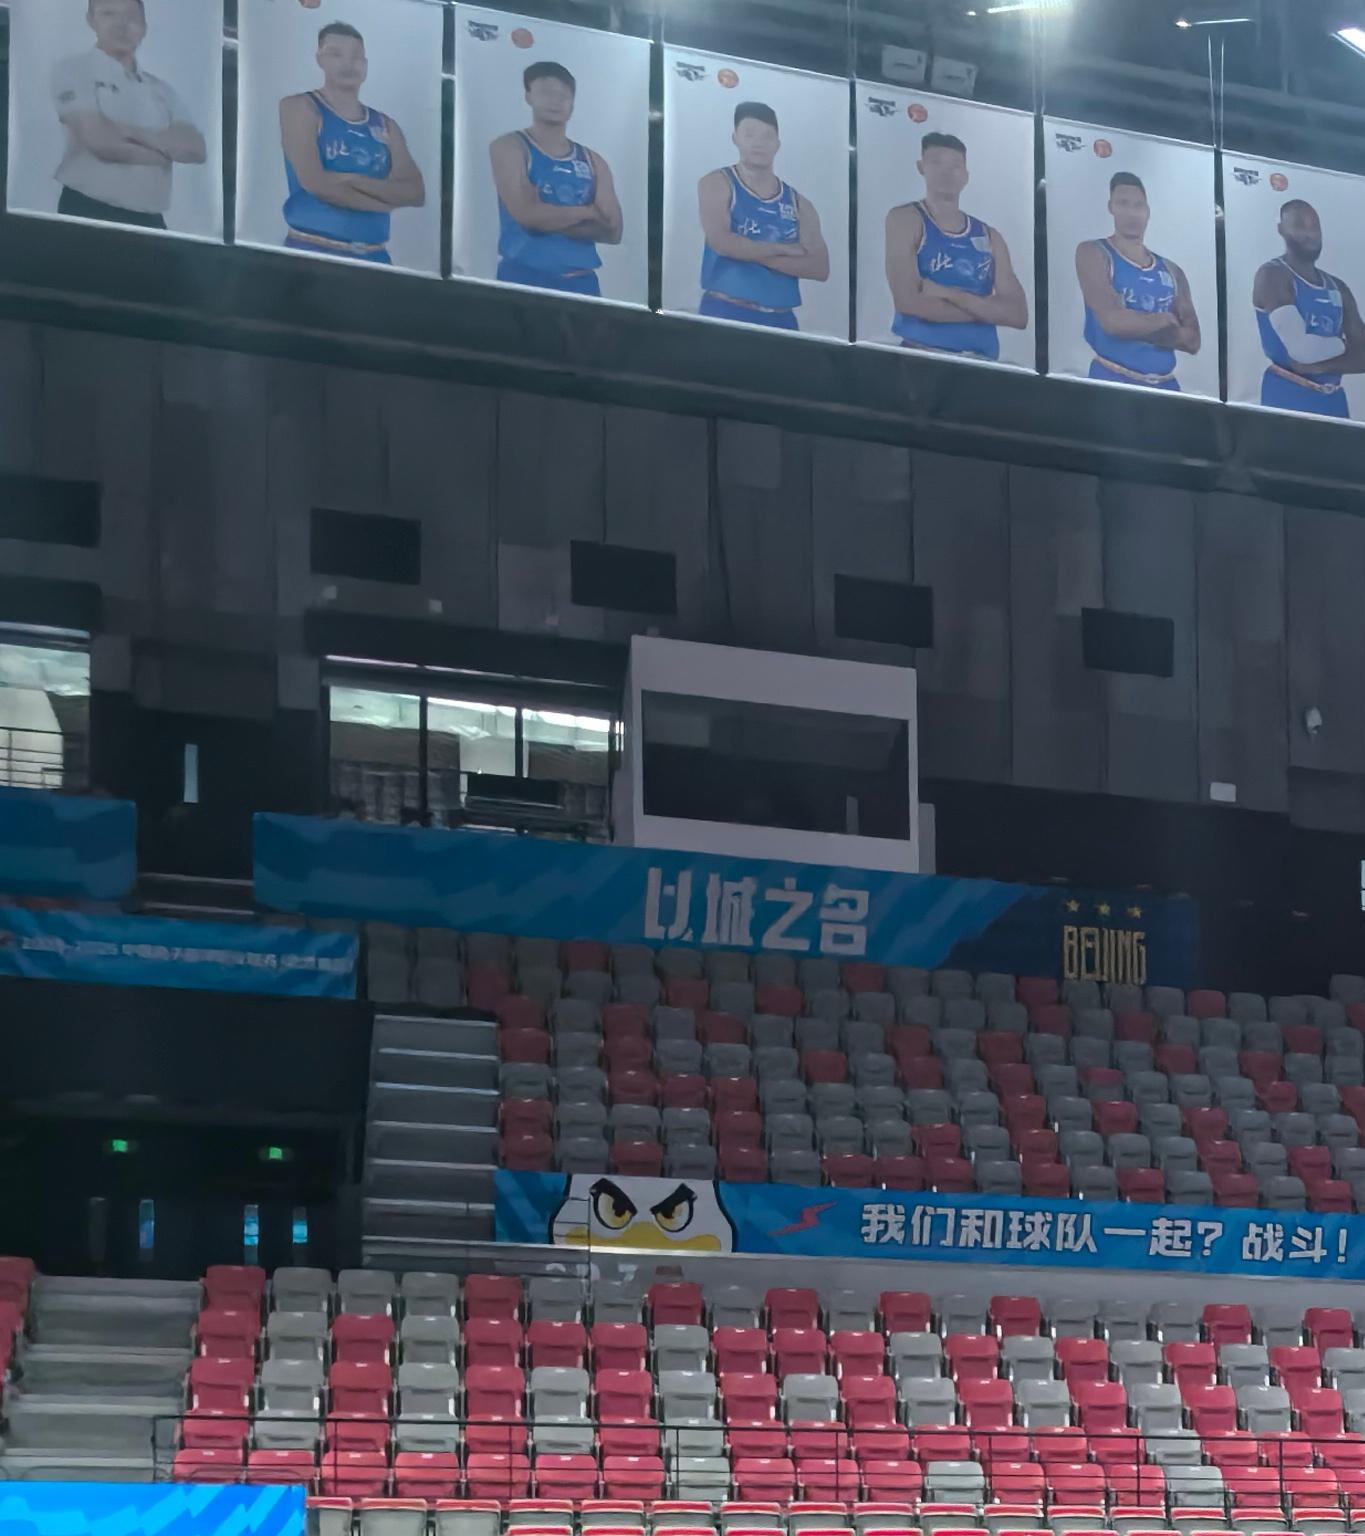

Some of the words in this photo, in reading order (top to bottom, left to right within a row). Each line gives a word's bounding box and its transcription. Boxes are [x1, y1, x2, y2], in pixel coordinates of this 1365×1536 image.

[643, 866, 869, 957] 以城之名
[1062, 925, 1148, 985] BEIJING
